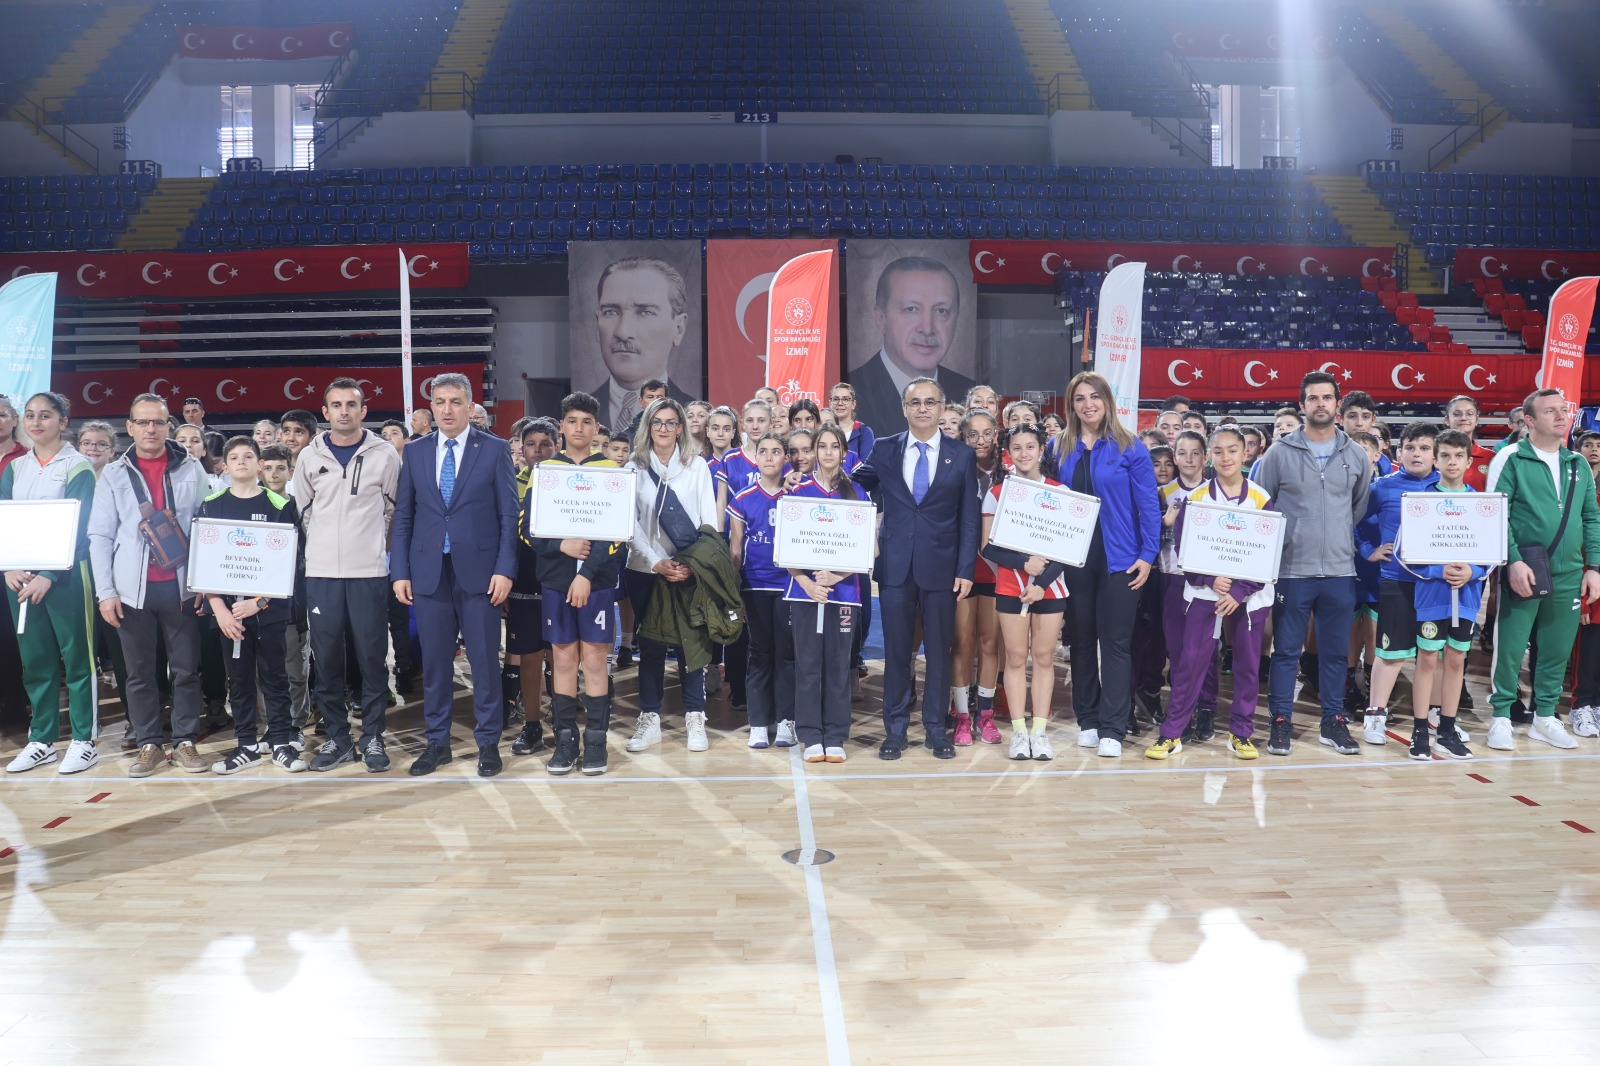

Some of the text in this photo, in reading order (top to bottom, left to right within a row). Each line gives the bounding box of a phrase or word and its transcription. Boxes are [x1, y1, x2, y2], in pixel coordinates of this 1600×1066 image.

[742, 113, 770, 123] 213
[121, 161, 154, 175] 115
[228, 159, 261, 171] 113
[1264, 157, 1296, 170] 113
[1369, 161, 1397, 173] 111
[786, 328, 812, 336] GENÇLİK
[790, 335, 821, 343] BAKANLIĞI
[785, 345, 809, 356] İZMİR
[1109, 353, 1127, 363] İZMİR
[1556, 356, 1574, 369] İZMİR
[8, 361, 33, 372] İZMİR
[553, 499, 580, 507] SELÇUK
[1004, 508, 1044, 523] KAYMAKAM
[1044, 518, 1067, 530] ÖZGÜR
[799, 529, 849, 539] BORNOVA ÖZEL
[1010, 518, 1075, 540] KURAK ORTAOKULU
[791, 537, 858, 548] BİLFEN ORTAOKULU
[1029, 532, 1054, 543] (İZMİR)
[1197, 534, 1215, 542] URLA
[1216, 536, 1233, 545] ÖZEL
[812, 547, 837, 555] (İZMİR)
[1210, 545, 1253, 556] ORTAOKULU
[224, 554, 261, 563] BEYENDİK
[1217, 555, 1243, 563] (İZMİR)
[219, 563, 264, 572] ORTAOKULU
[594, 610, 606, 631] 4
